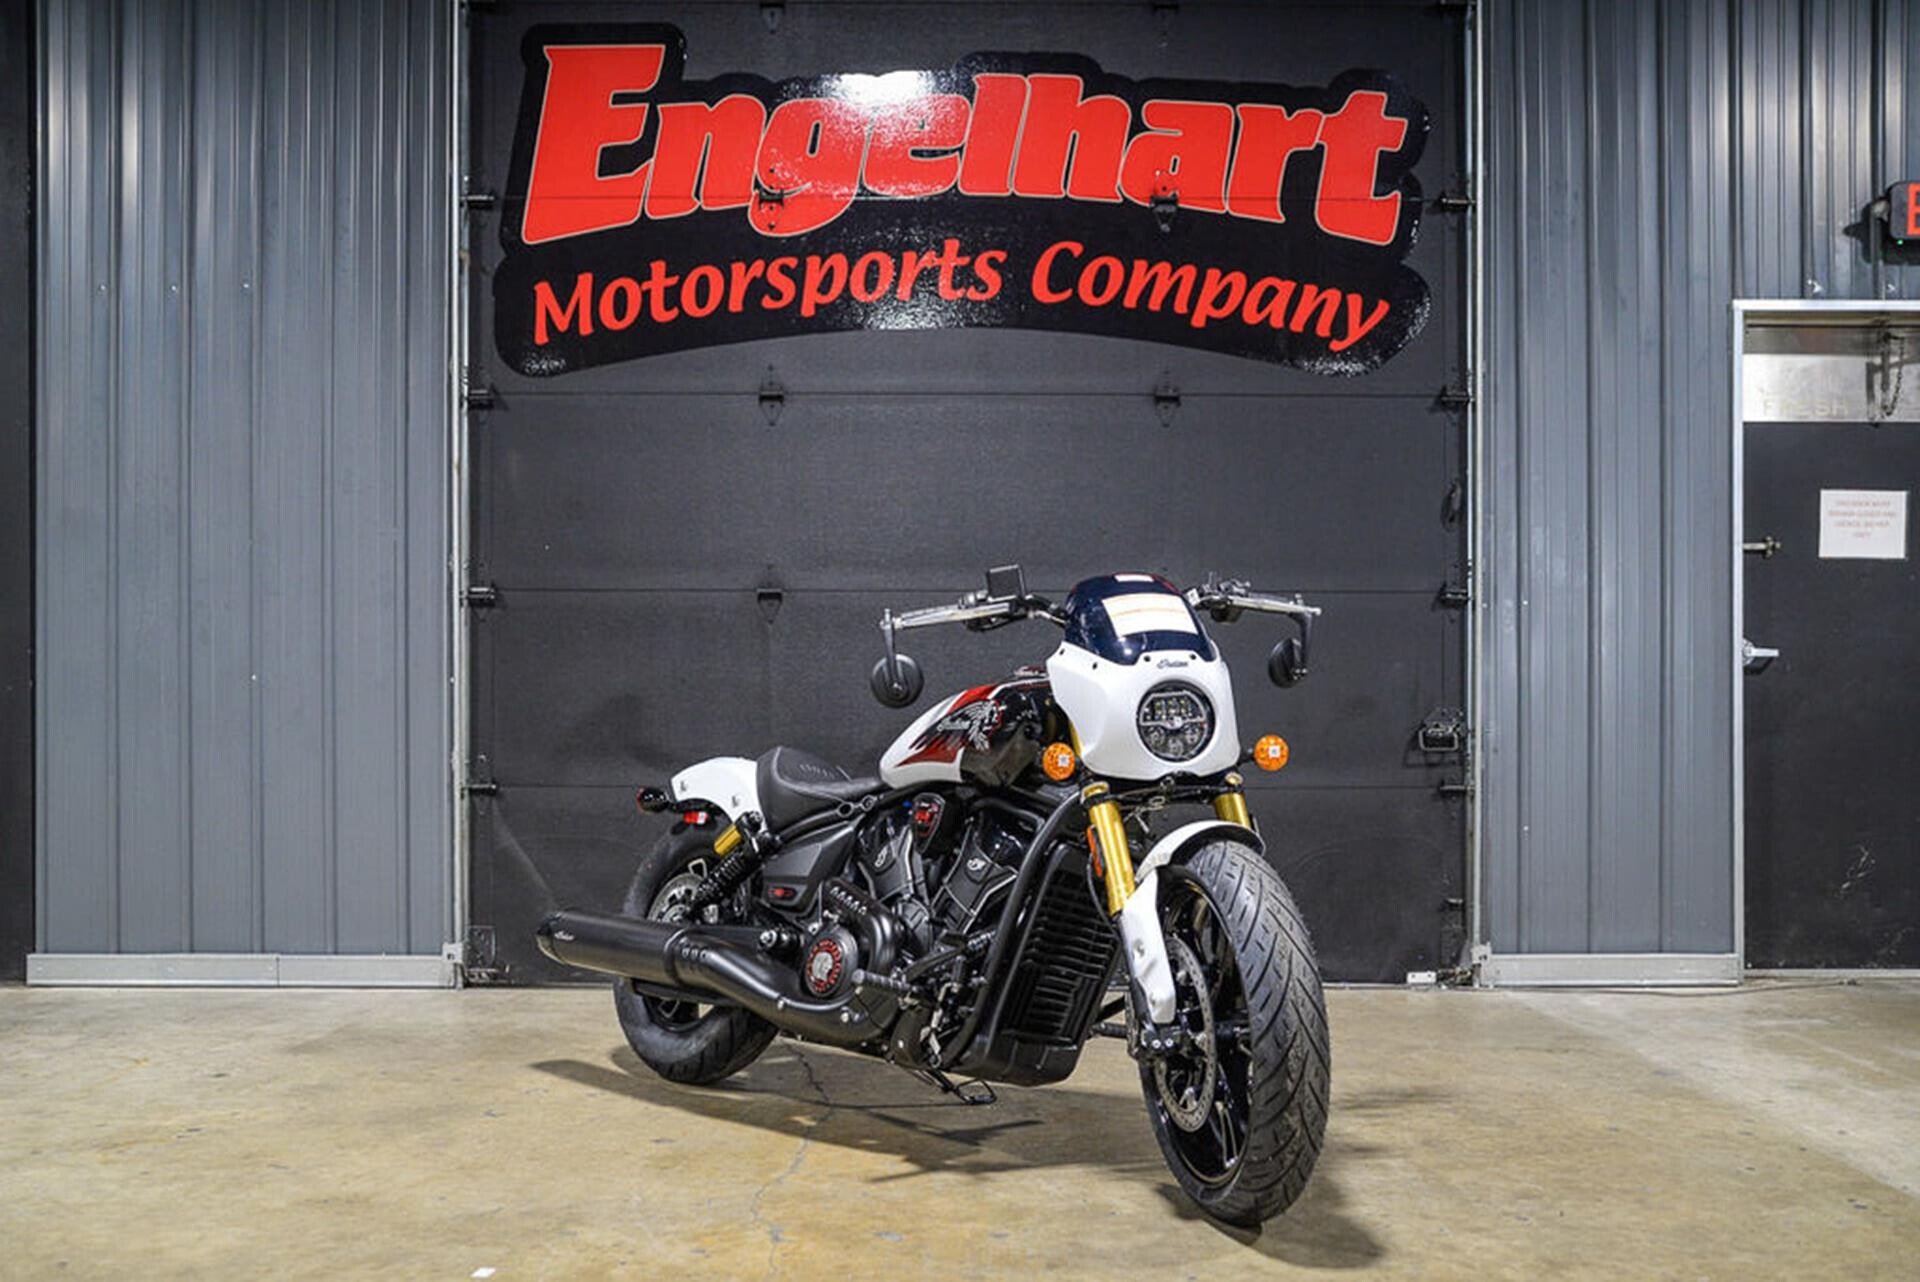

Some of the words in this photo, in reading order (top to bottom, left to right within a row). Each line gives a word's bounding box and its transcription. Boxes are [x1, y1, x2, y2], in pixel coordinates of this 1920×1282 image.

[522, 44, 1408, 245] Engelhart
[534, 238, 1007, 346] Motorsports
[1031, 241, 1390, 352] Company
